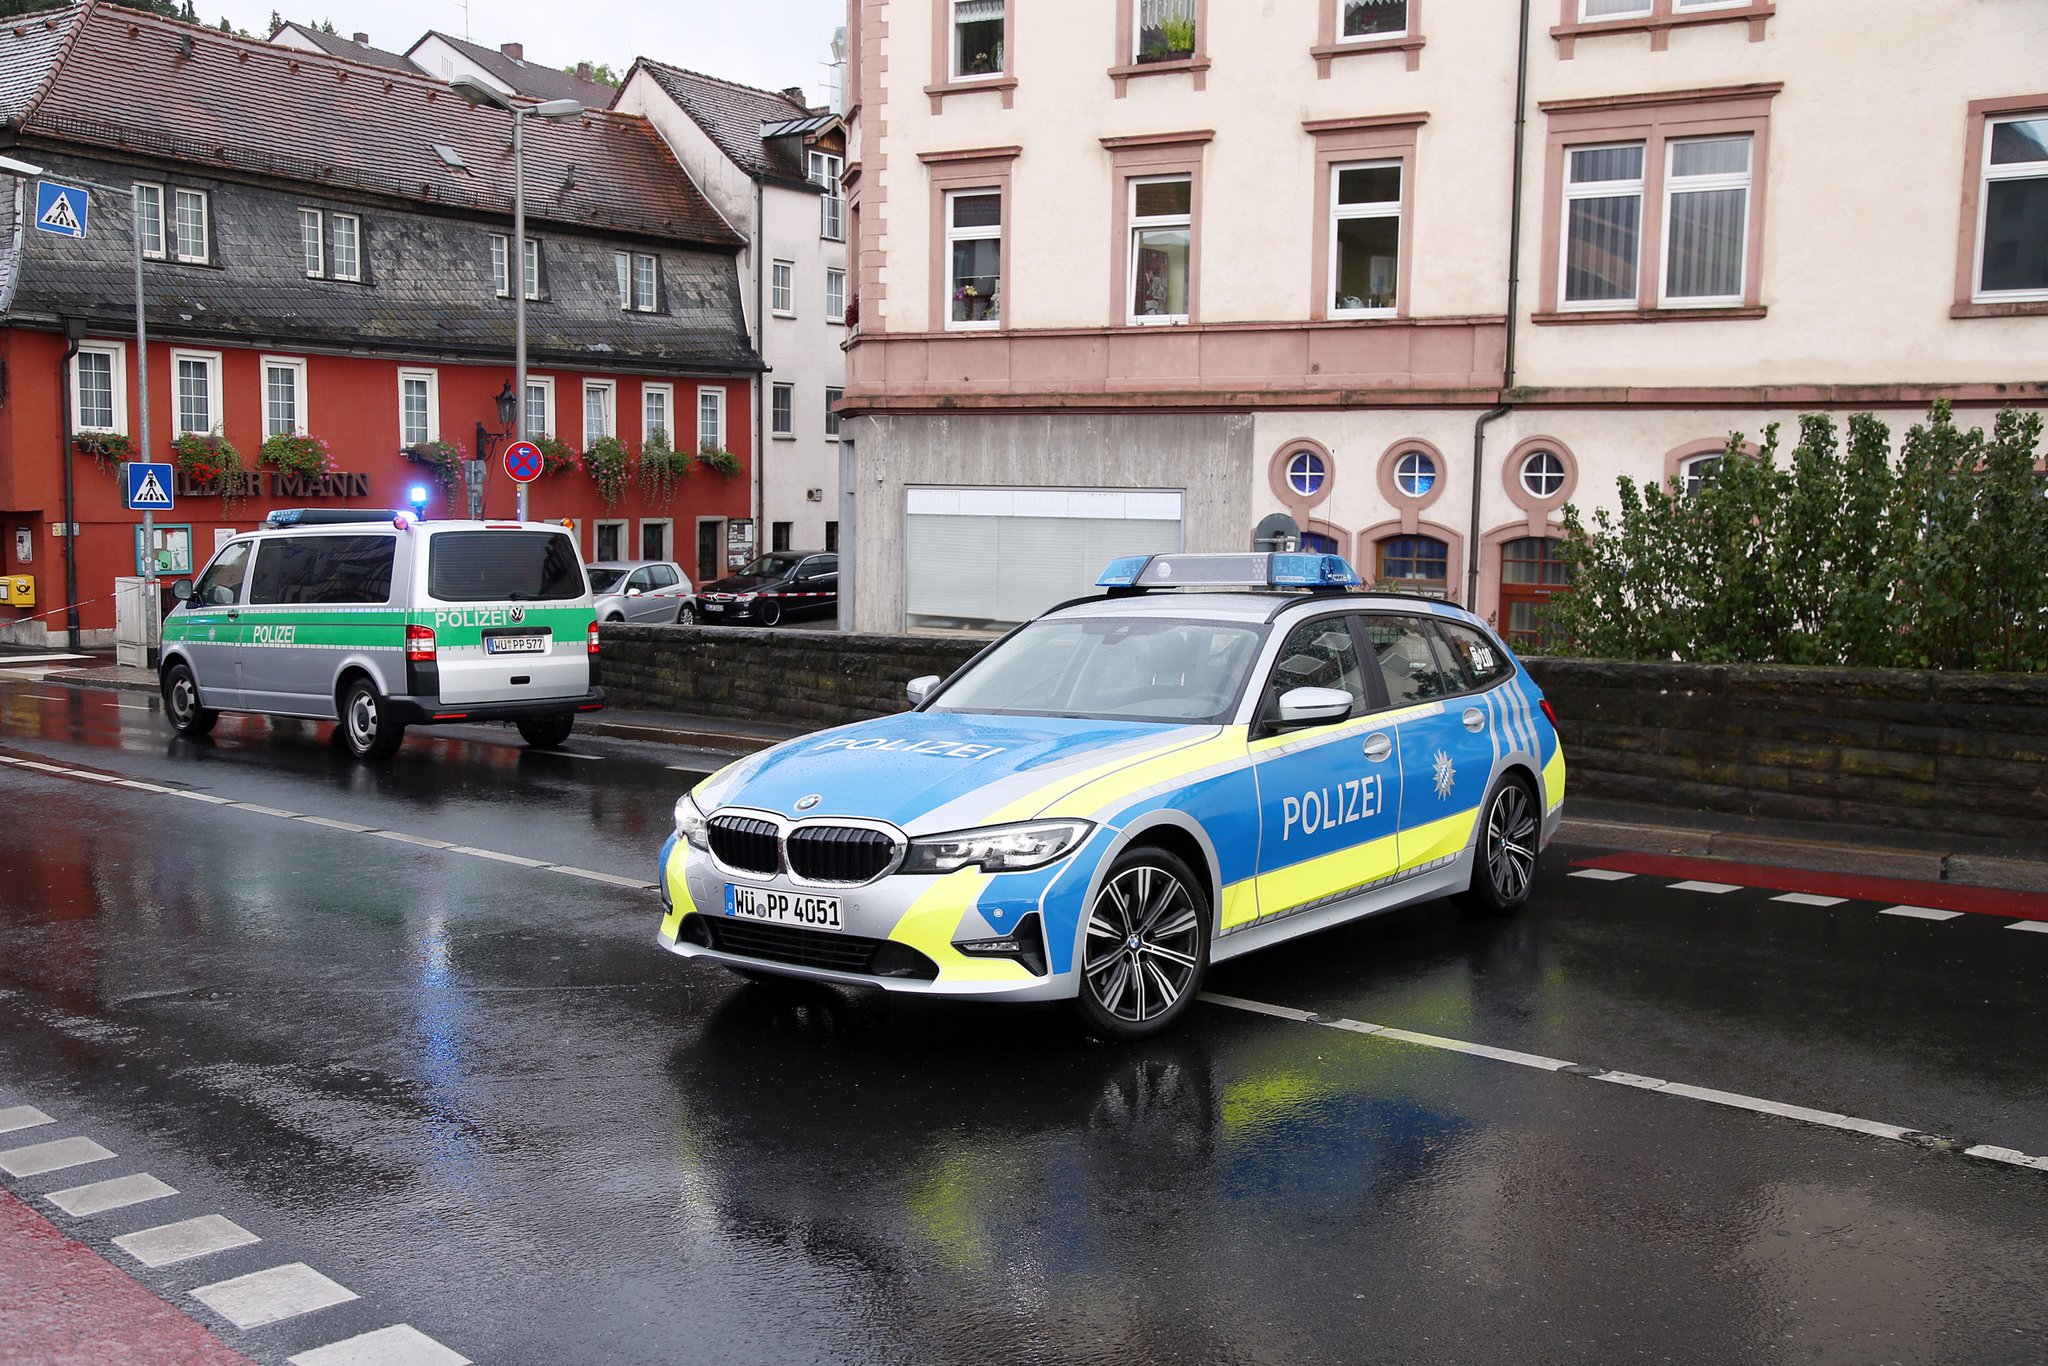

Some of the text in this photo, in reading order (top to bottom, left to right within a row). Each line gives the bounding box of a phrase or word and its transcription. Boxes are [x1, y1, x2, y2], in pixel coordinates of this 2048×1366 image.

[271, 471, 369, 496] MANN
[435, 611, 507, 628] POLIZEI
[253, 626, 296, 643] POLIZEI
[513, 639, 524, 649] PP
[526, 638, 543, 649] 577
[814, 738, 1006, 760] POLIZEI
[1283, 774, 1382, 841] POLIZEI
[735, 888, 755, 916] WÜ
[767, 893, 788, 919] PP
[794, 897, 840, 926] 4051
